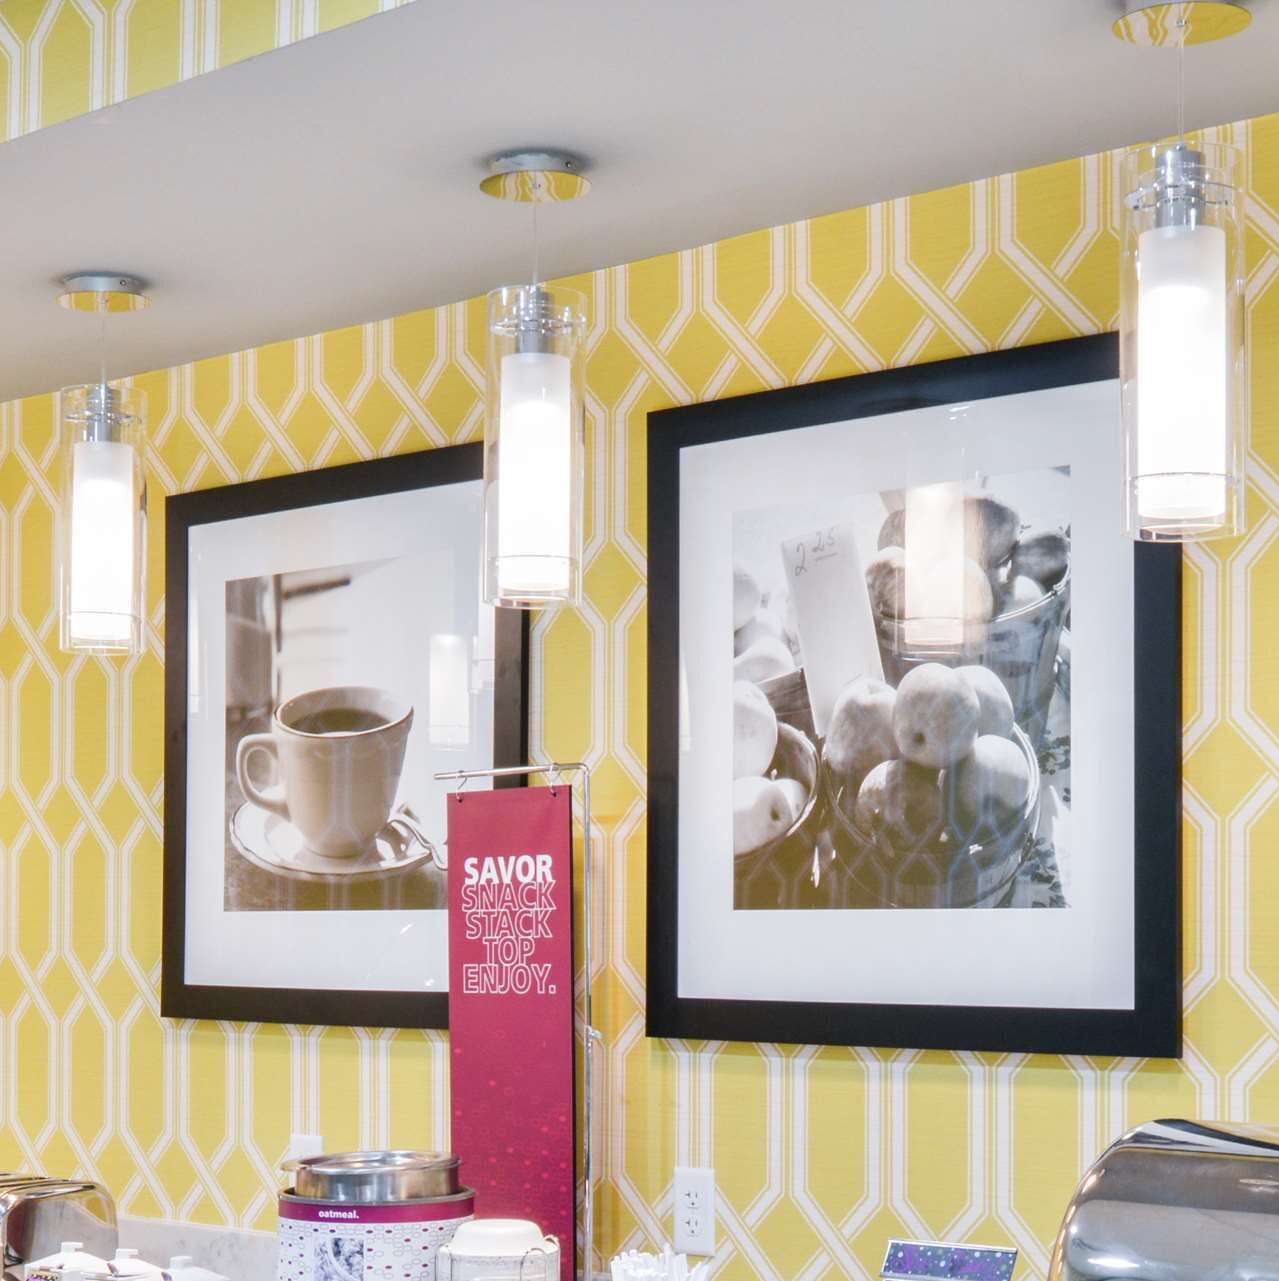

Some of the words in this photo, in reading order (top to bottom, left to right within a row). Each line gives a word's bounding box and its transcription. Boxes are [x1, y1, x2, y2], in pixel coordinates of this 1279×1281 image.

[463, 854, 554, 885] SAVOR
[462, 880, 556, 912] SNACK
[466, 909, 552, 939] STACK
[483, 935, 535, 967] TOP
[463, 963, 556, 994] ENJOY.
[318, 1209, 360, 1219] oatmeal.
